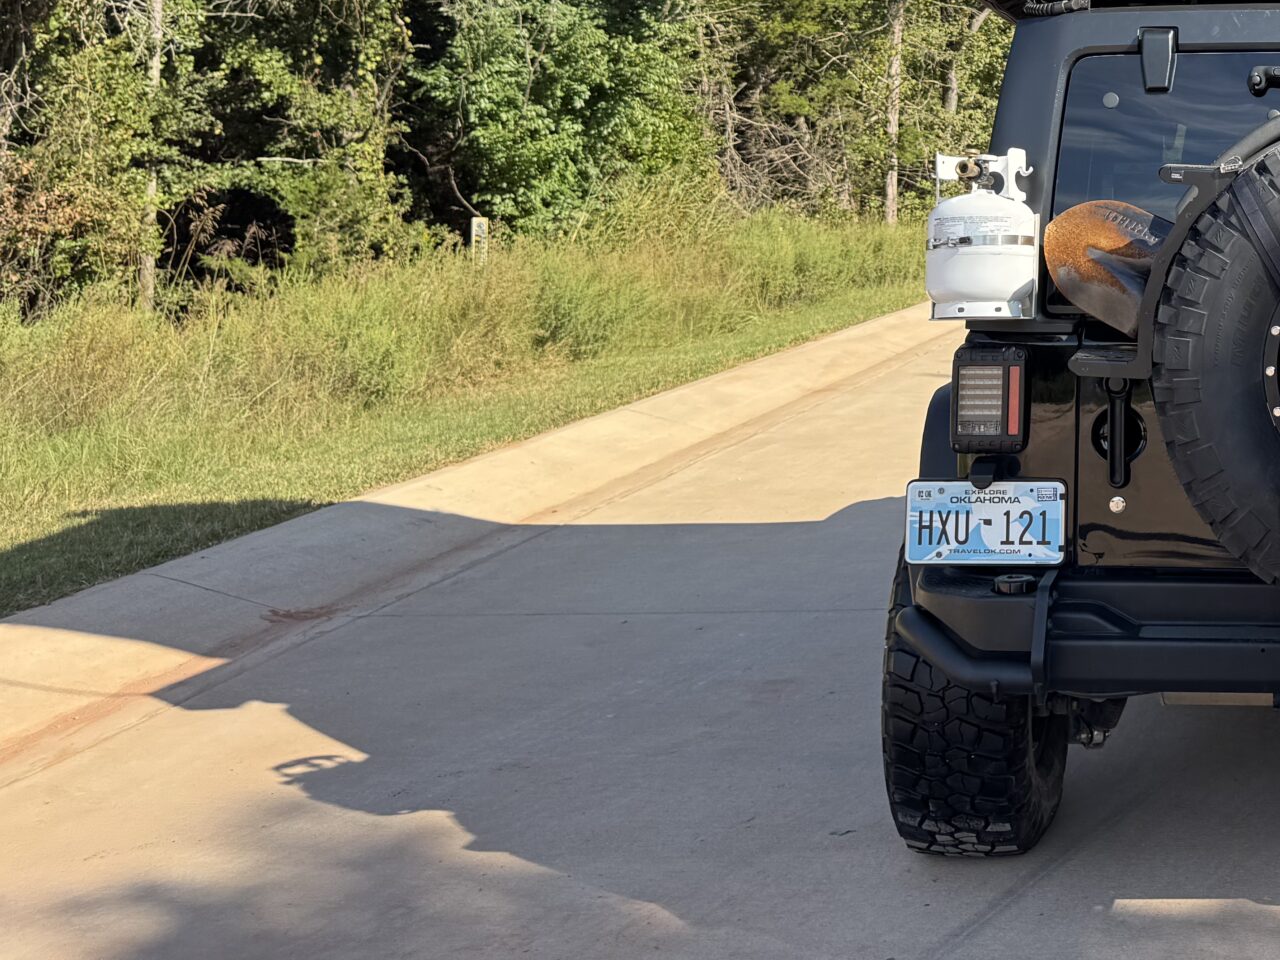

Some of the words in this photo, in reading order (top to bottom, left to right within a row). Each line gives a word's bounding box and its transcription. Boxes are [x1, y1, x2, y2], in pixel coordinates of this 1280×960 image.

[950, 496, 1021, 504] OKLAHOMA
[917, 510, 971, 546] HXU
[1000, 510, 1051, 546] 121
